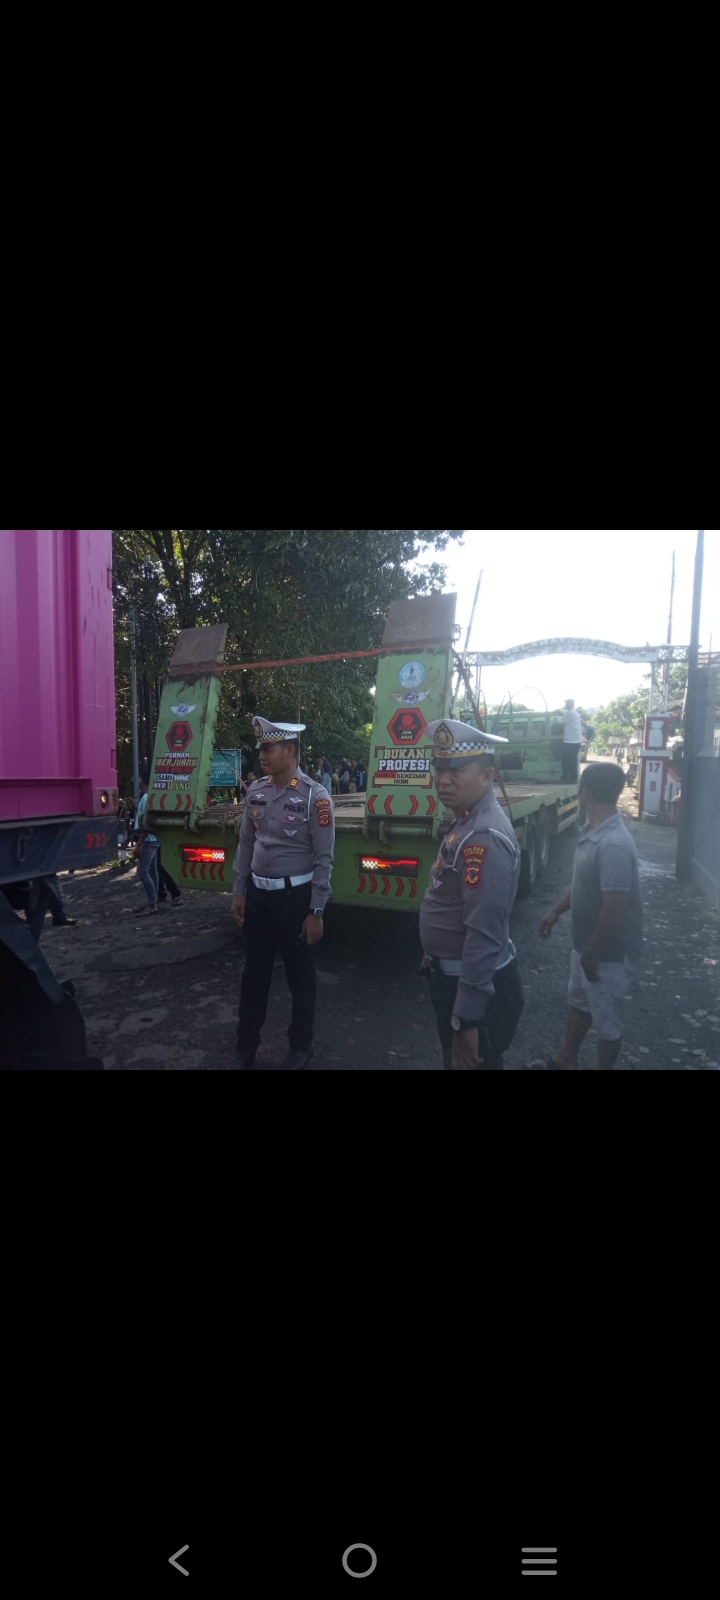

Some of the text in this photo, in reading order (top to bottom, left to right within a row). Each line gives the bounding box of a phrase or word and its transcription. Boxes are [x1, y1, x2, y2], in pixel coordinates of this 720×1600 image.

[383, 749, 425, 759] BUKAN
[156, 758, 197, 766] BERJUANG
[378, 759, 430, 771] PROFESI
[648, 762, 661, 773] 17
[167, 781, 191, 791] UANG
[283, 803, 305, 813] POLRI
